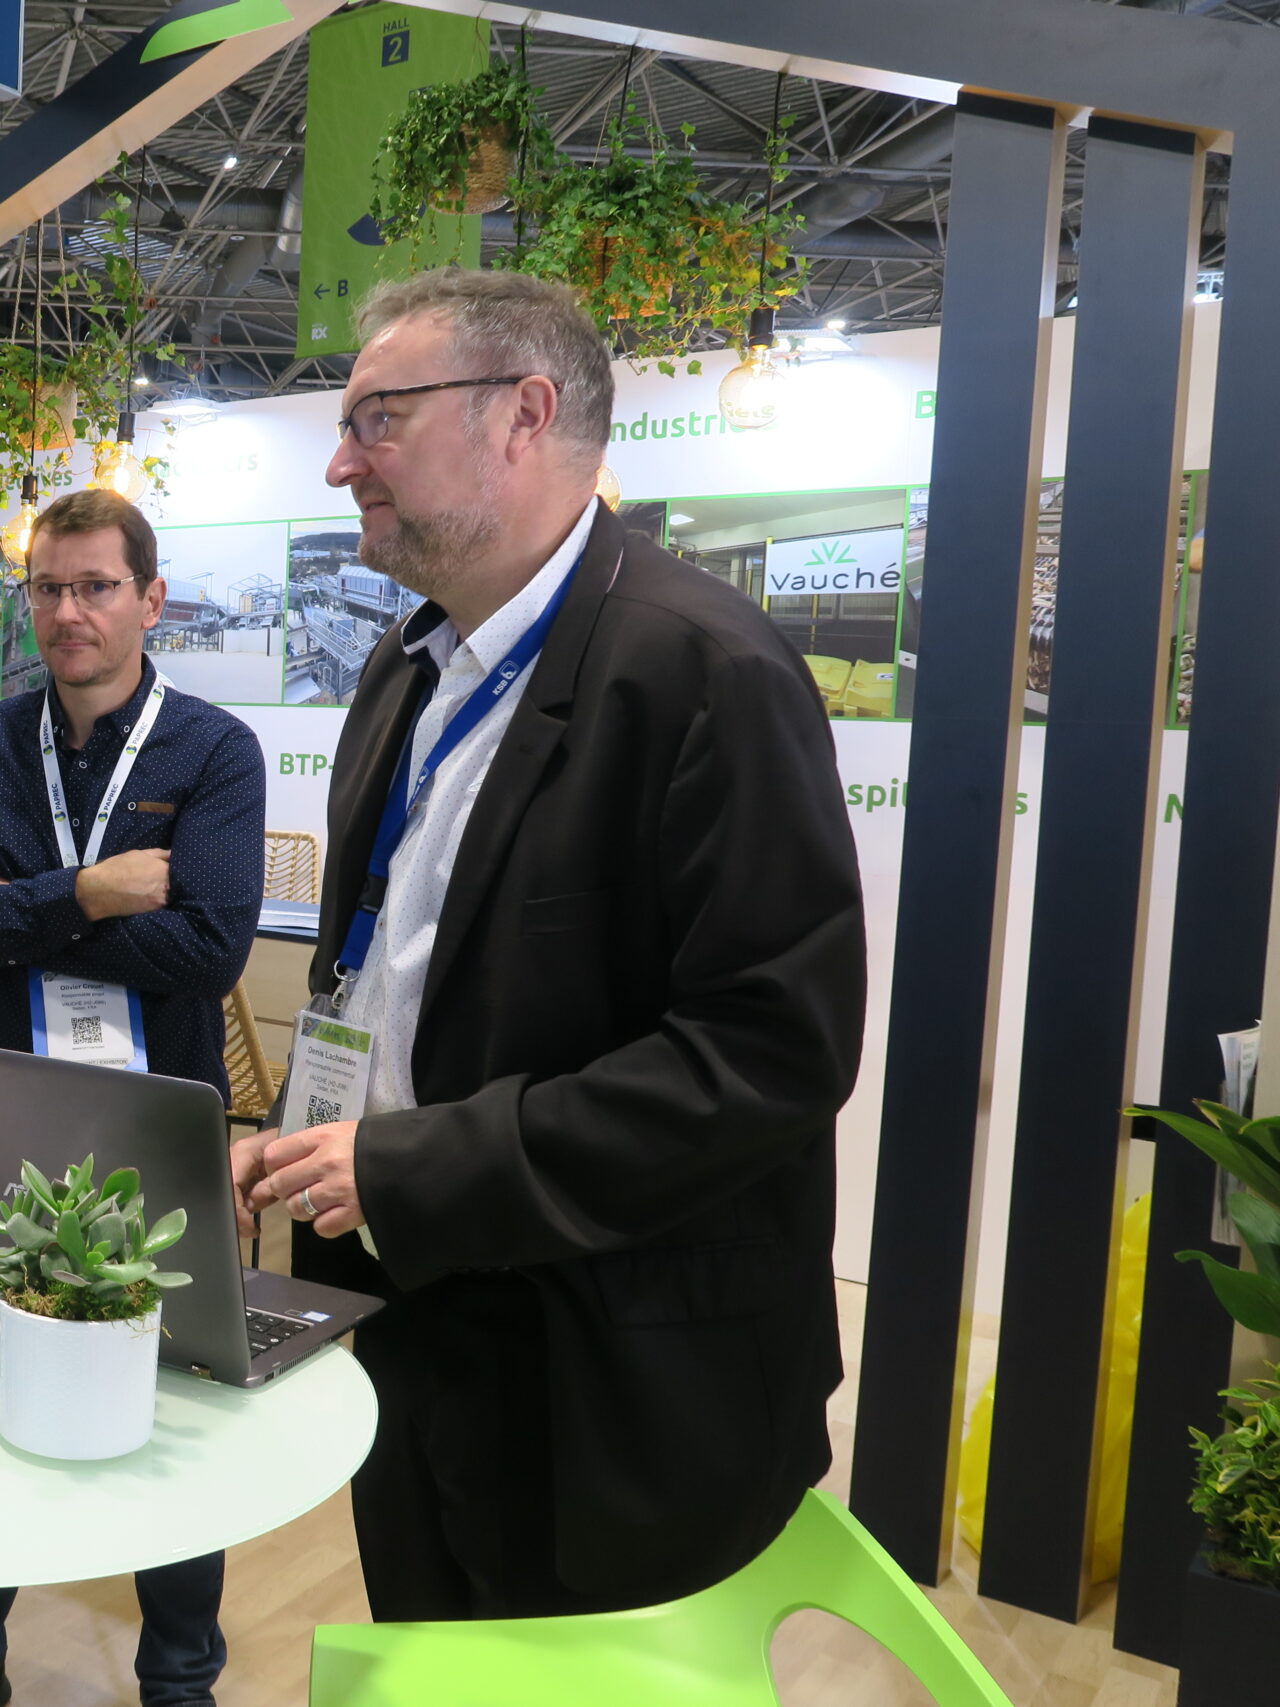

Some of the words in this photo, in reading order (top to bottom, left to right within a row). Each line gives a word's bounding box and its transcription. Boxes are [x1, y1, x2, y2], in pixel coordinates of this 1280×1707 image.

[383, 17, 410, 33] HALL
[388, 36, 403, 63] 2
[337, 279, 349, 297] B
[770, 562, 901, 591] Vauché
[492, 680, 508, 695] KSB
[132, 721, 149, 745] PAPREC
[51, 783, 62, 810] PAPREC
[104, 783, 119, 811] PAPREC
[307, 1046, 324, 1058] Denis
[324, 1050, 357, 1068] Lachambre
